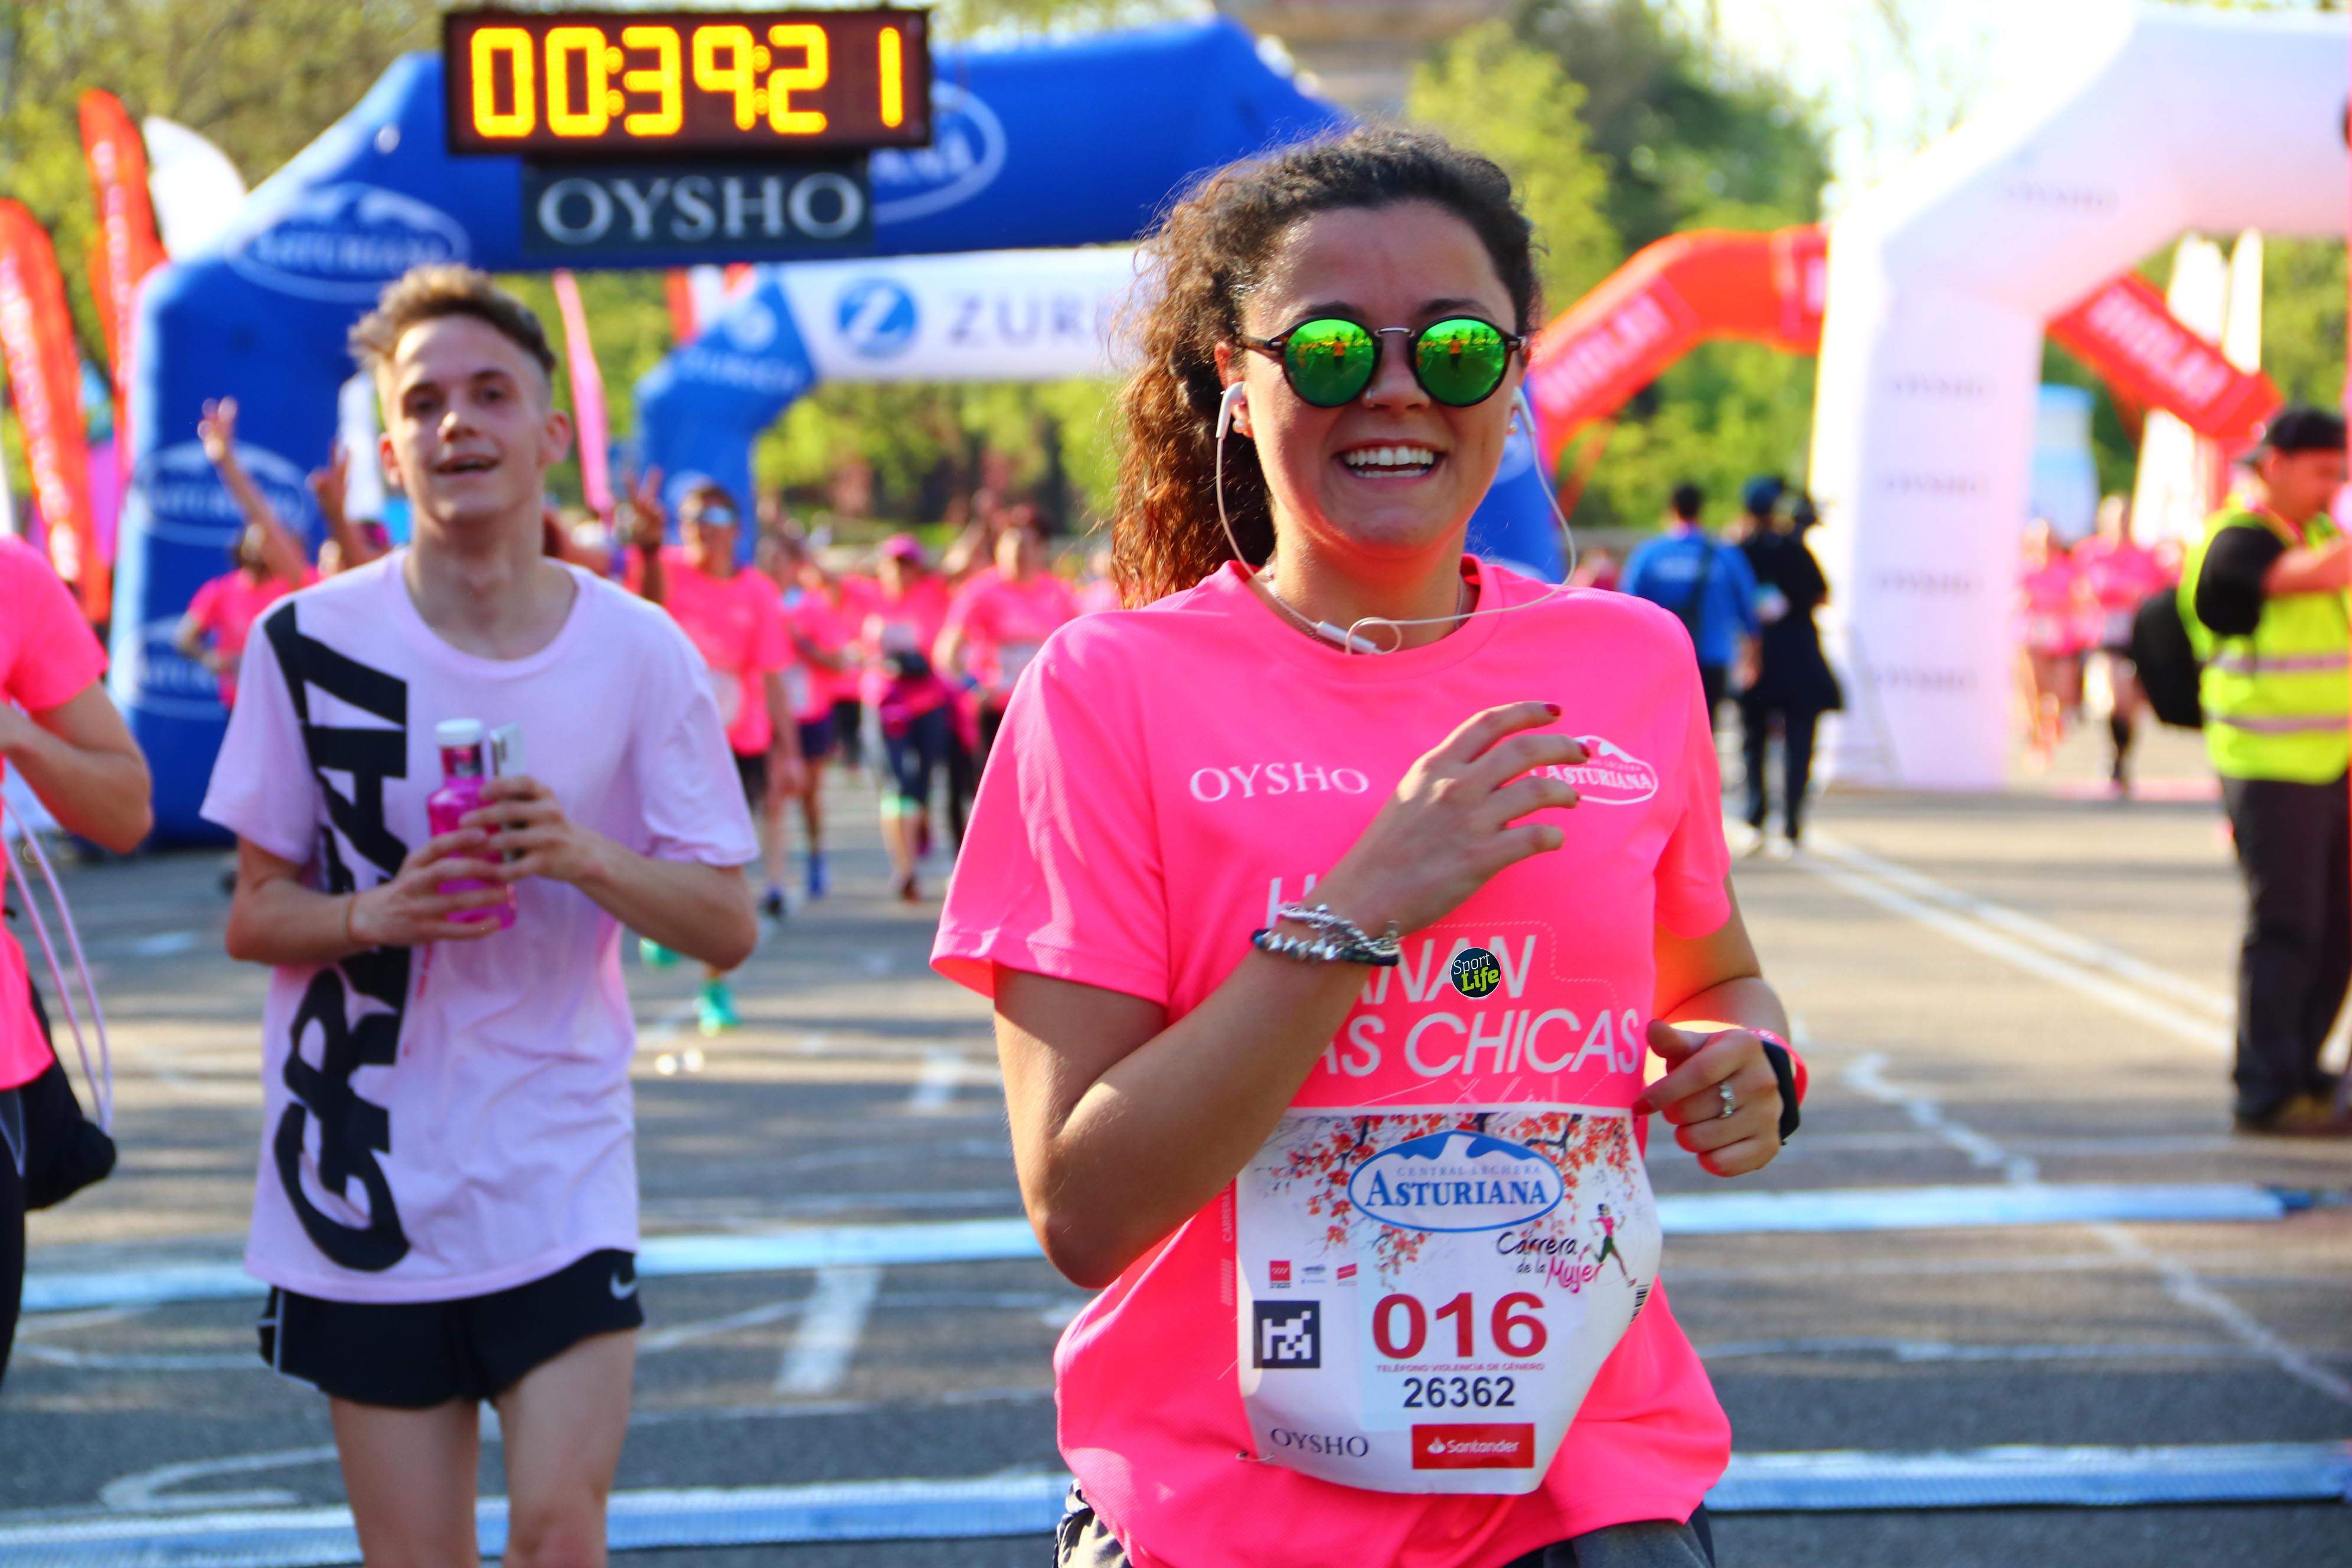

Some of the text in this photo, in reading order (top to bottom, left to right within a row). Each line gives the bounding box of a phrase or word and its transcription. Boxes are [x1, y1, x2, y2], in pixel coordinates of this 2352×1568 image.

[538, 172, 864, 244] OYSHO
[1189, 762, 1369, 802] OYSHO
[1361, 934, 1536, 1005] NAN
[1404, 1008, 1639, 1077] CHICAS
[1365, 1170, 1548, 1206] ASTURIANA
[1497, 1231, 1577, 1255] Carrera
[1517, 1244, 1603, 1293] de la Mujer
[1373, 1291, 1548, 1360] 016
[1403, 1376, 1515, 1408] 26362
[1270, 1427, 1370, 1458] OYSHO
[1446, 1439, 1520, 1454] Santander
